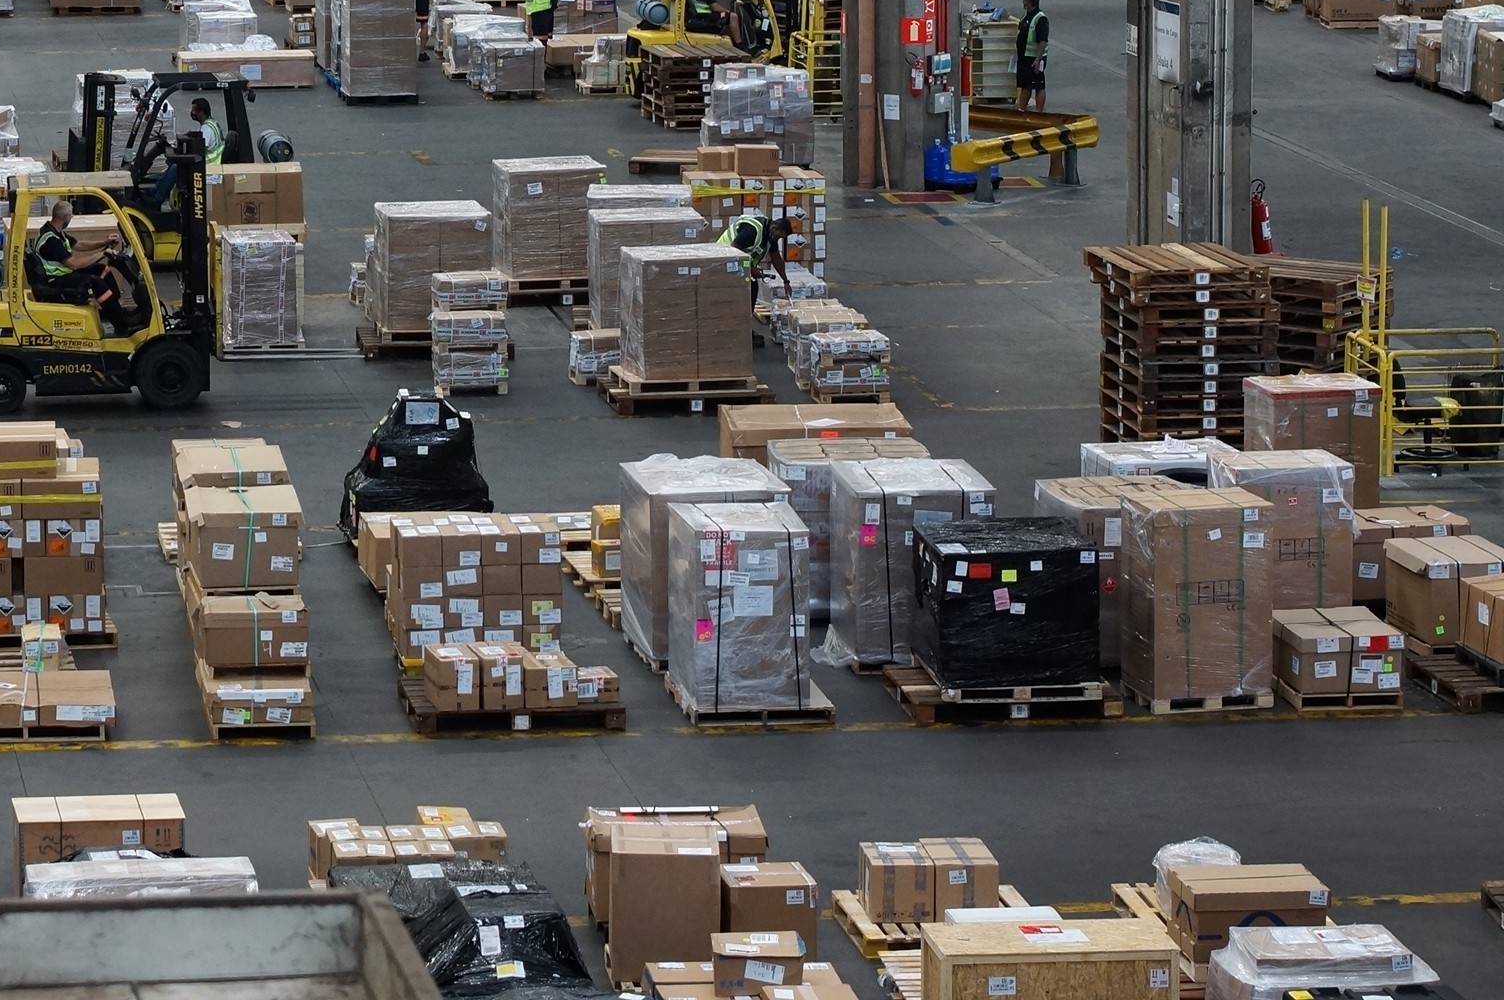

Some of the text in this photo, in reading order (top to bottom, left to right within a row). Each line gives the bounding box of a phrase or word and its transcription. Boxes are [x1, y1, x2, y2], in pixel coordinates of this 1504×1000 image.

[193, 172, 203, 219] HYSTER
[22, 337, 52, 346] E142
[52, 339, 83, 347] HYSTER
